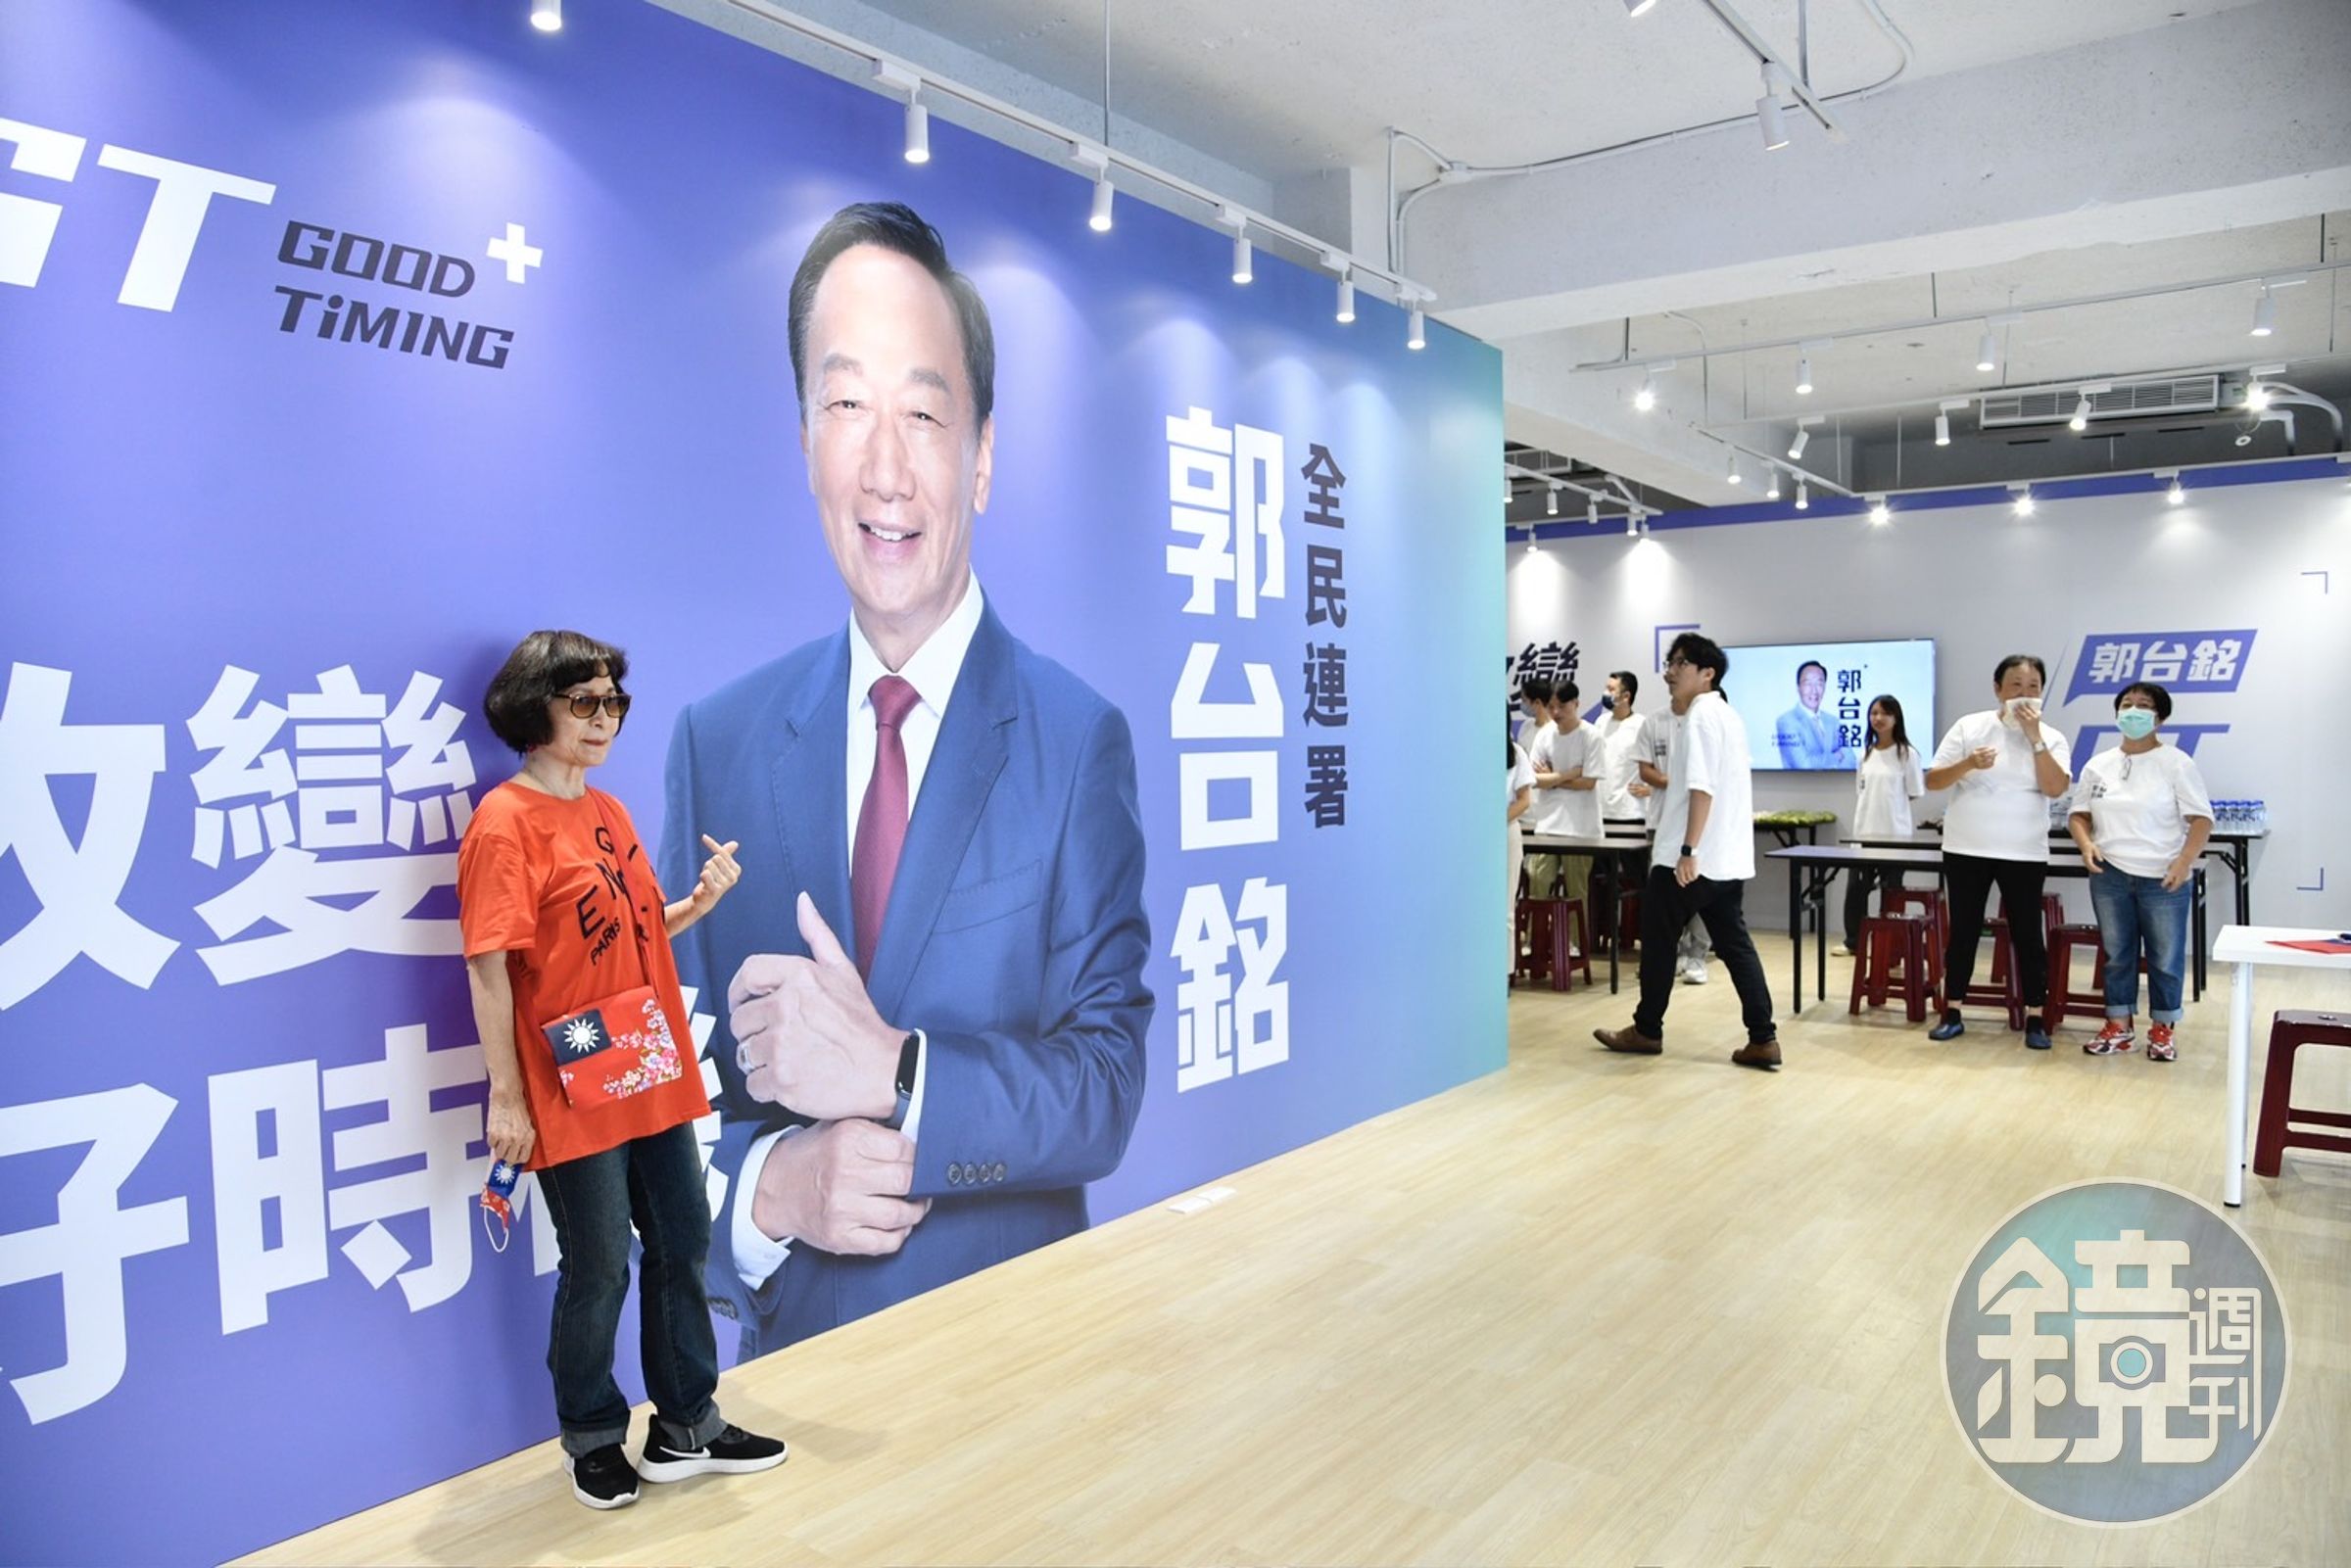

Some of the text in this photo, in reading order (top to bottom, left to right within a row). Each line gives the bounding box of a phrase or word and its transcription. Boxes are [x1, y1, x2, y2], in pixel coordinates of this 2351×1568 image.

[277, 219, 476, 298] GOOD
[1301, 443, 1349, 830] 全民連署
[2088, 639, 2242, 684] 郭台銘
[1837, 669, 1862, 747] 郭台銘
[1166, 405, 1289, 1093] 郭台銘
